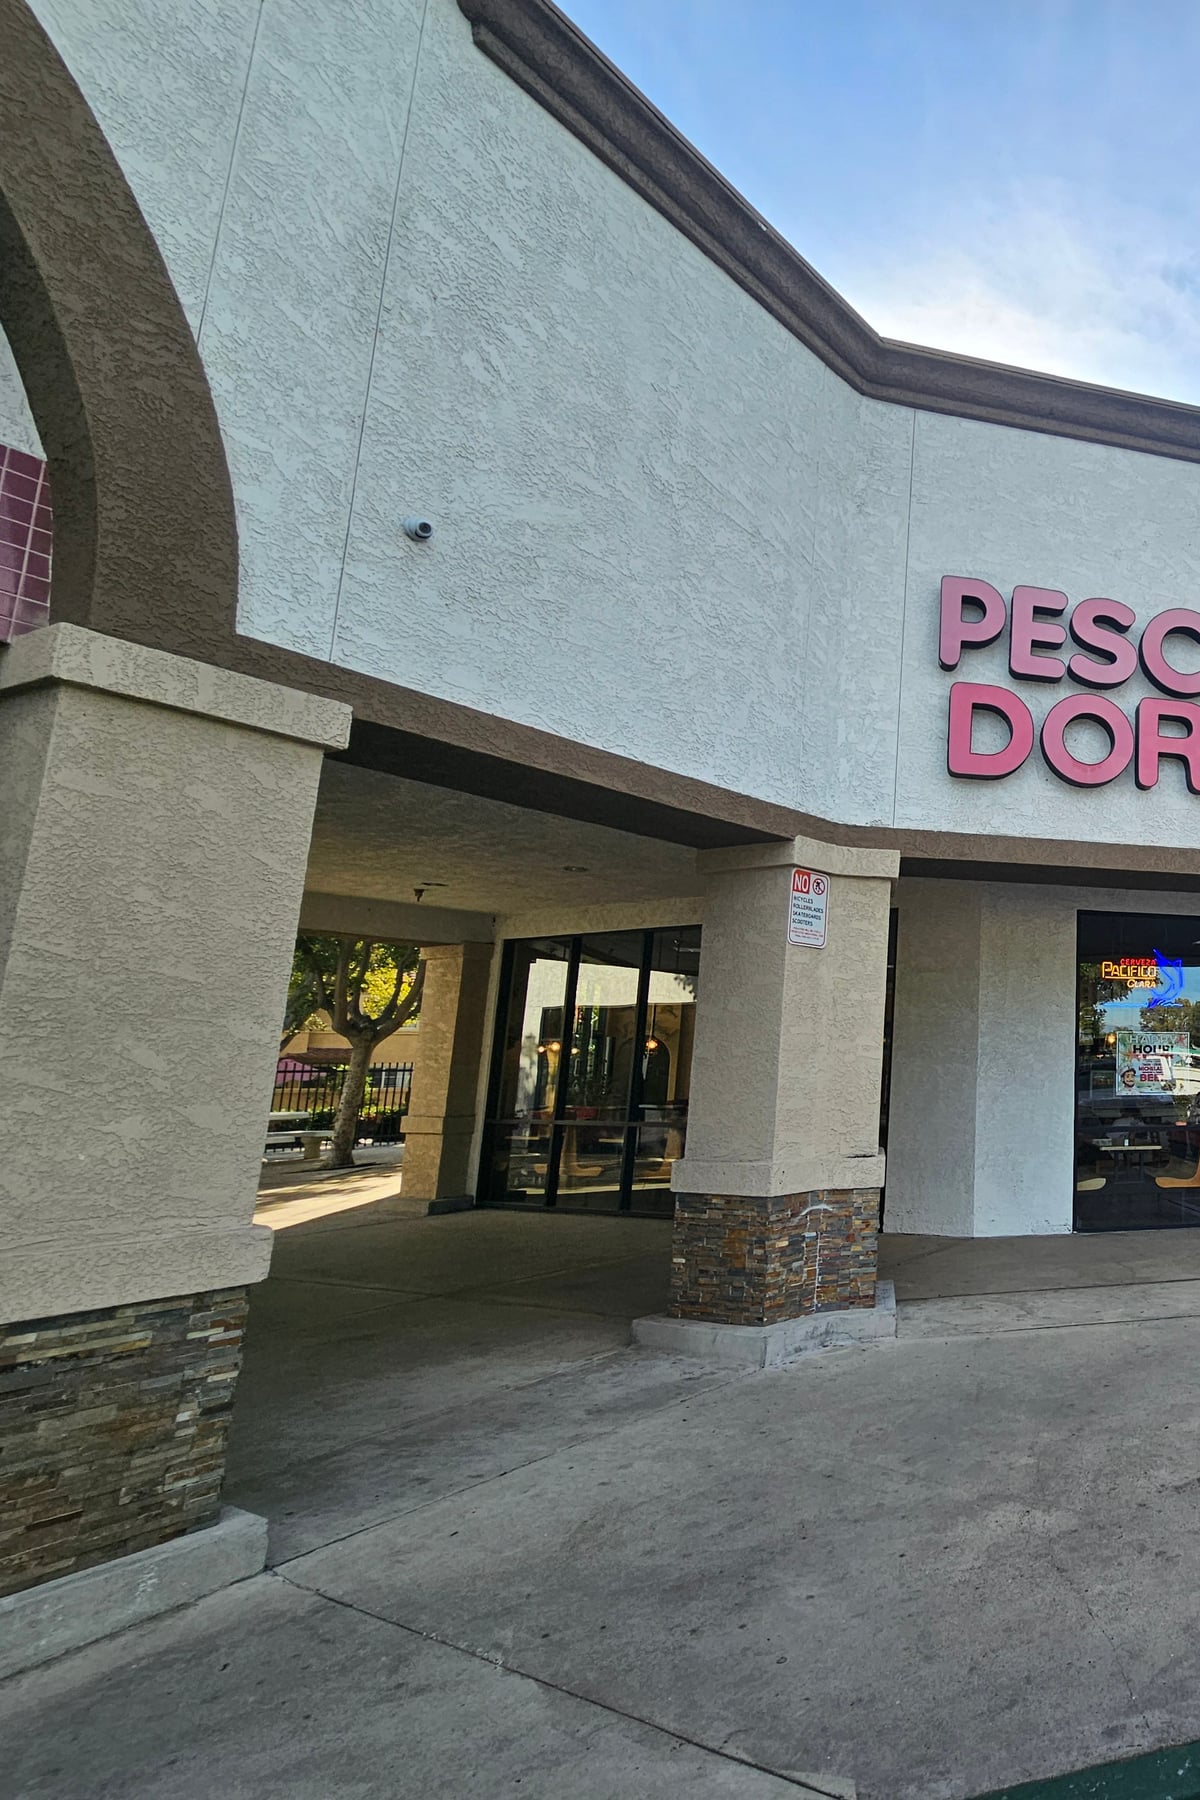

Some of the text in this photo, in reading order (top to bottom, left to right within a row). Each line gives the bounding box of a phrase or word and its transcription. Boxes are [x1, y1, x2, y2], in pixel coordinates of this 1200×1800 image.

[794, 874, 809, 892] NO
[793, 896, 813, 904] BICYCLES
[793, 903, 824, 914] ROLLERBLADES
[792, 911, 821, 920] SKATEBOARDS
[792, 918, 813, 926] SCOOTERS
[1120, 958, 1157, 966] CERVEZA
[1127, 978, 1157, 989] CLARA
